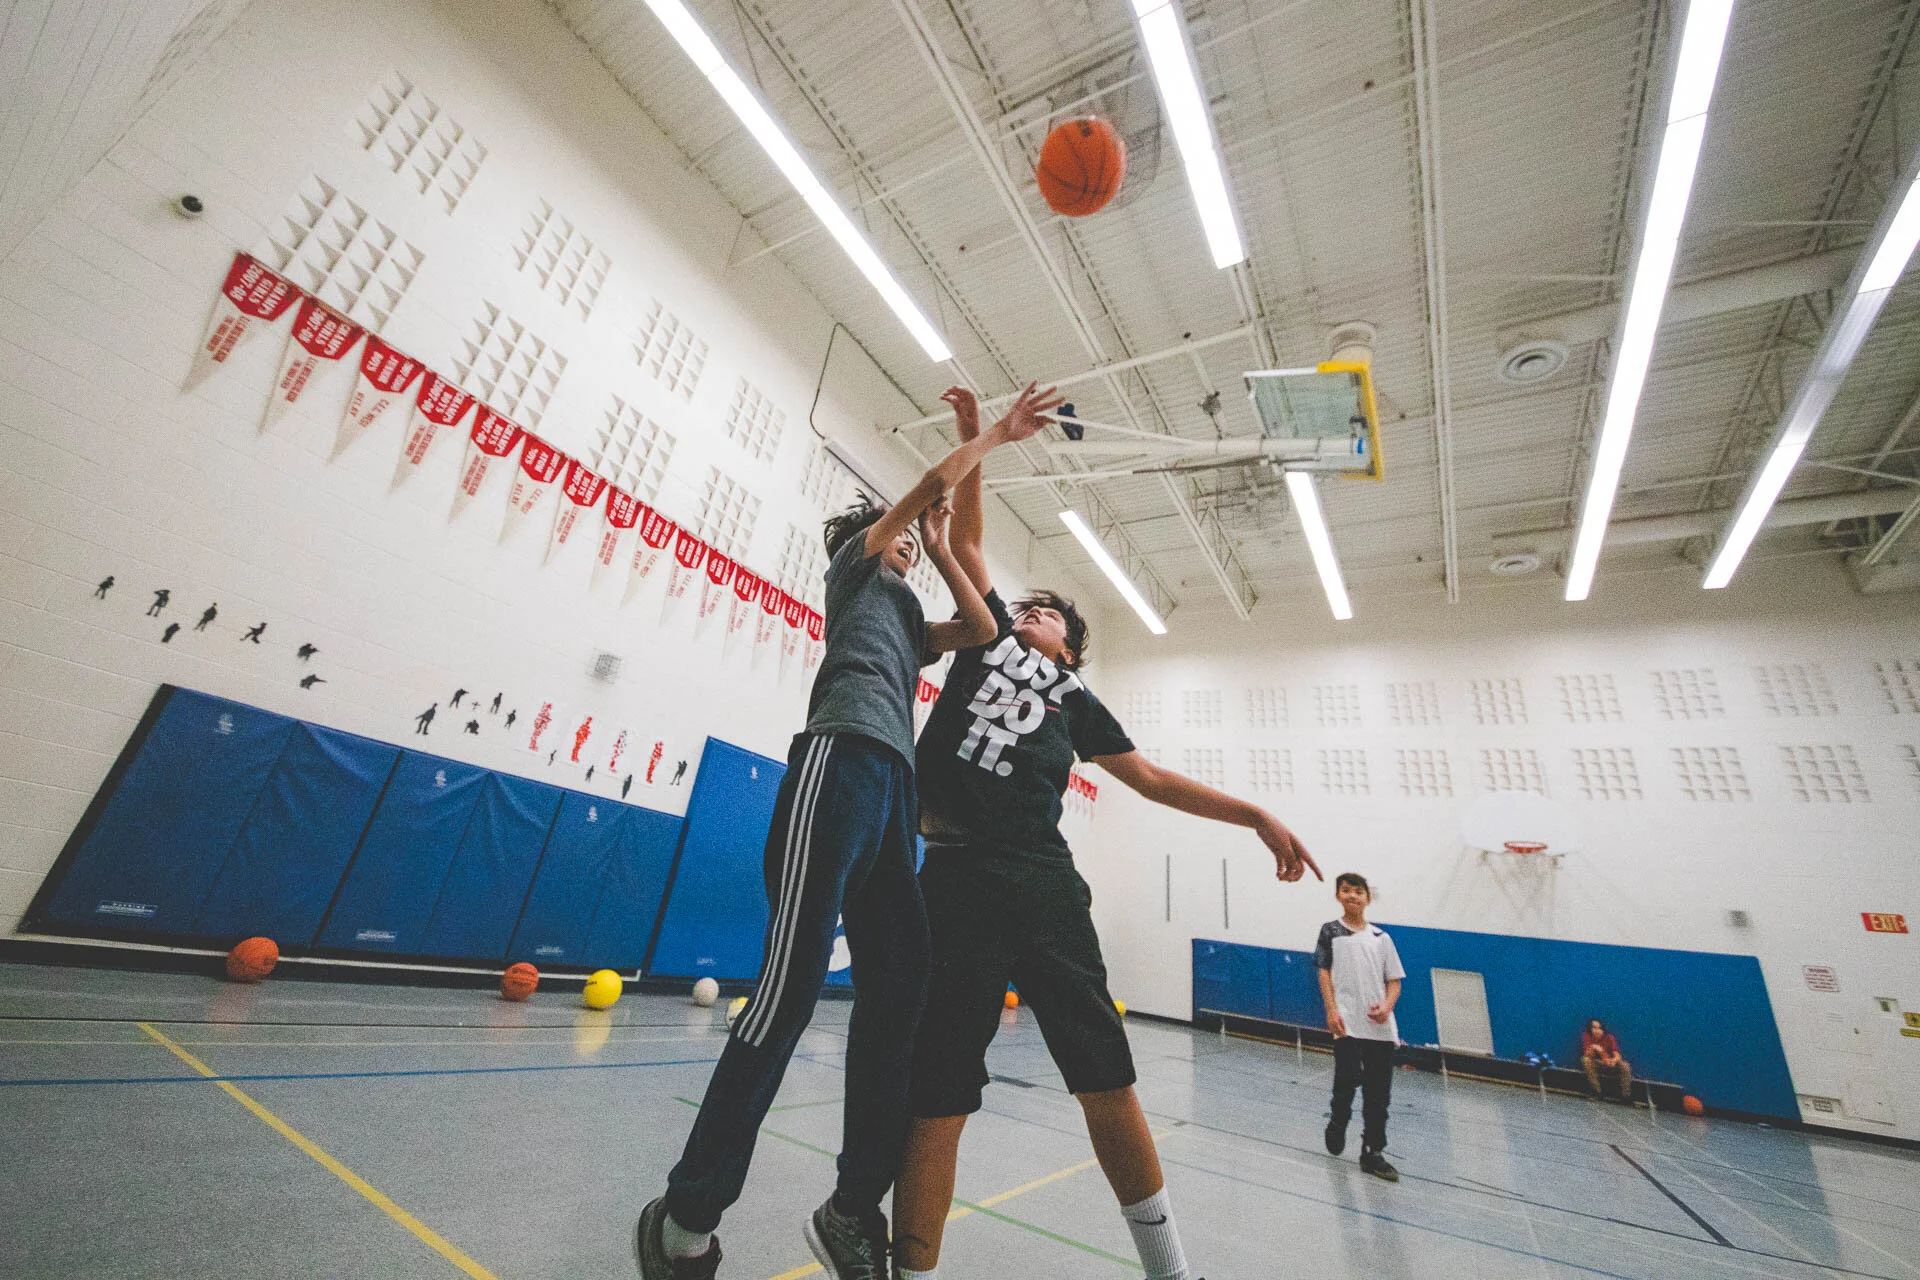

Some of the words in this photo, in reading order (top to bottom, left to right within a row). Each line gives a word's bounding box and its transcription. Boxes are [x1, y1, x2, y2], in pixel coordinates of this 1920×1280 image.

[228, 263, 263, 302] 2007-08
[248, 277, 273, 304] GIRLS
[256, 280, 288, 316] CHAMPS
[297, 307, 327, 343] 2007-08
[314, 319, 338, 346] GIRLS
[322, 322, 351, 356] CHAMPS
[365, 350, 384, 372] BOYS
[376, 354, 400, 384] JUNIOR
[434, 391, 452, 414] BOYS
[441, 391, 465, 424] CHAMPS
[487, 423, 503, 446] BOYS
[493, 423, 515, 455] CHAMPS
[523, 447, 538, 465] BOYS
[533, 451, 549, 472] ATOM
[577, 476, 590, 496] BOYS
[582, 476, 599, 505] CHAMPS
[616, 500, 629, 519] BOYS
[622, 500, 637, 527] CHAMPS
[982, 635, 1084, 704] JUST
[967, 670, 1045, 734] DO
[956, 716, 1019, 776] IT.
